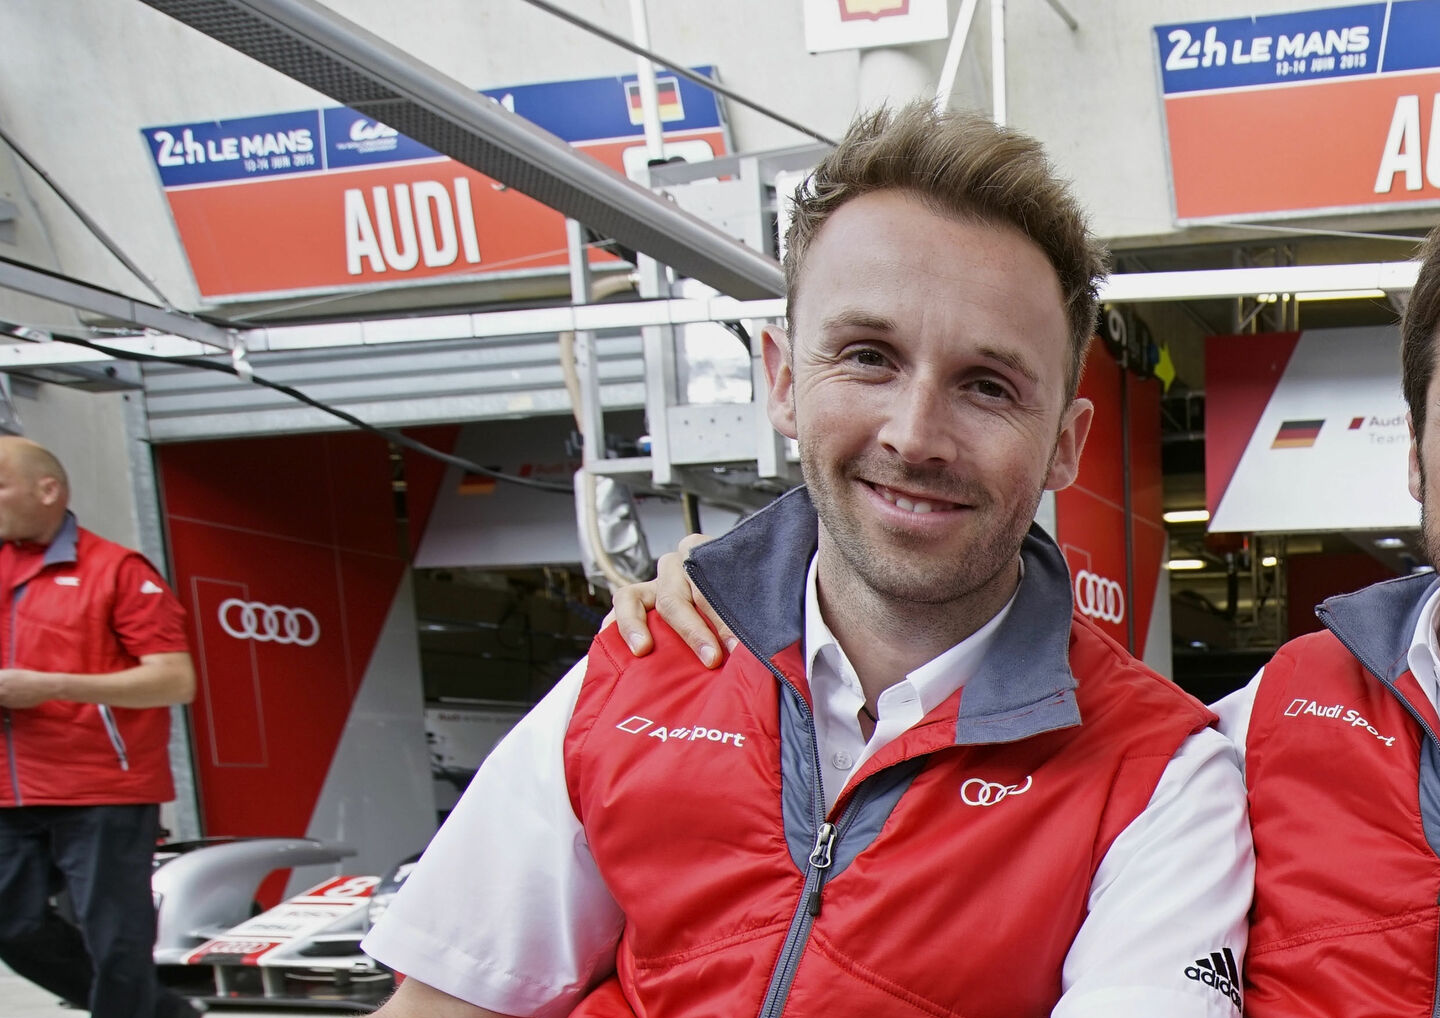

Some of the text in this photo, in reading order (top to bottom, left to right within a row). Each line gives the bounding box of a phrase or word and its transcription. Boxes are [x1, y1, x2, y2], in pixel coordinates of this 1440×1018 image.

[1165, 26, 1370, 70] 24h LE MANS
[153, 128, 206, 168] 24h
[207, 138, 240, 162] LE
[241, 129, 314, 159] MANS
[344, 176, 482, 276] AUDI
[1303, 700, 1396, 747] Audi Sport
[1183, 966, 1242, 1014] adida
